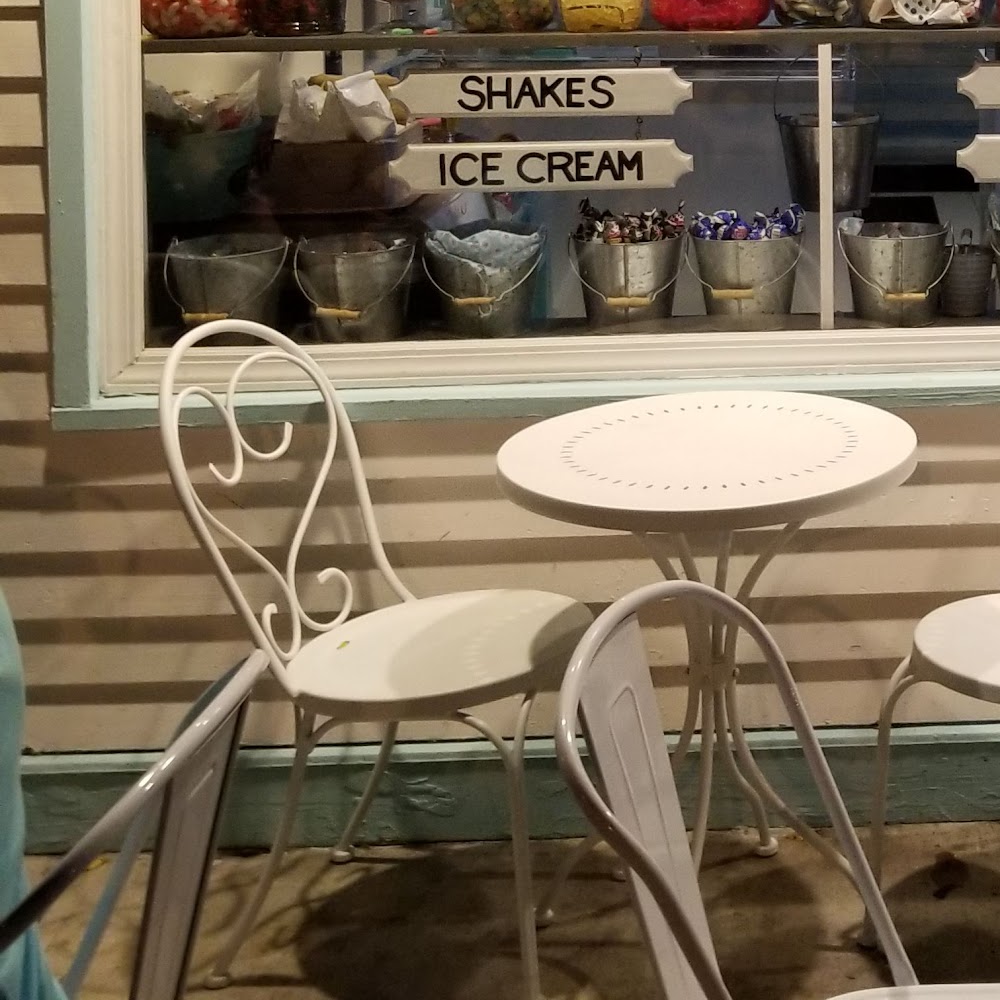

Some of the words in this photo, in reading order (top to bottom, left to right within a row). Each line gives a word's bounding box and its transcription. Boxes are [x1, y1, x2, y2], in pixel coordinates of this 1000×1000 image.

[457, 75, 616, 112] SHAKES
[439, 152, 504, 186] ICE
[516, 150, 644, 183] CREAM
